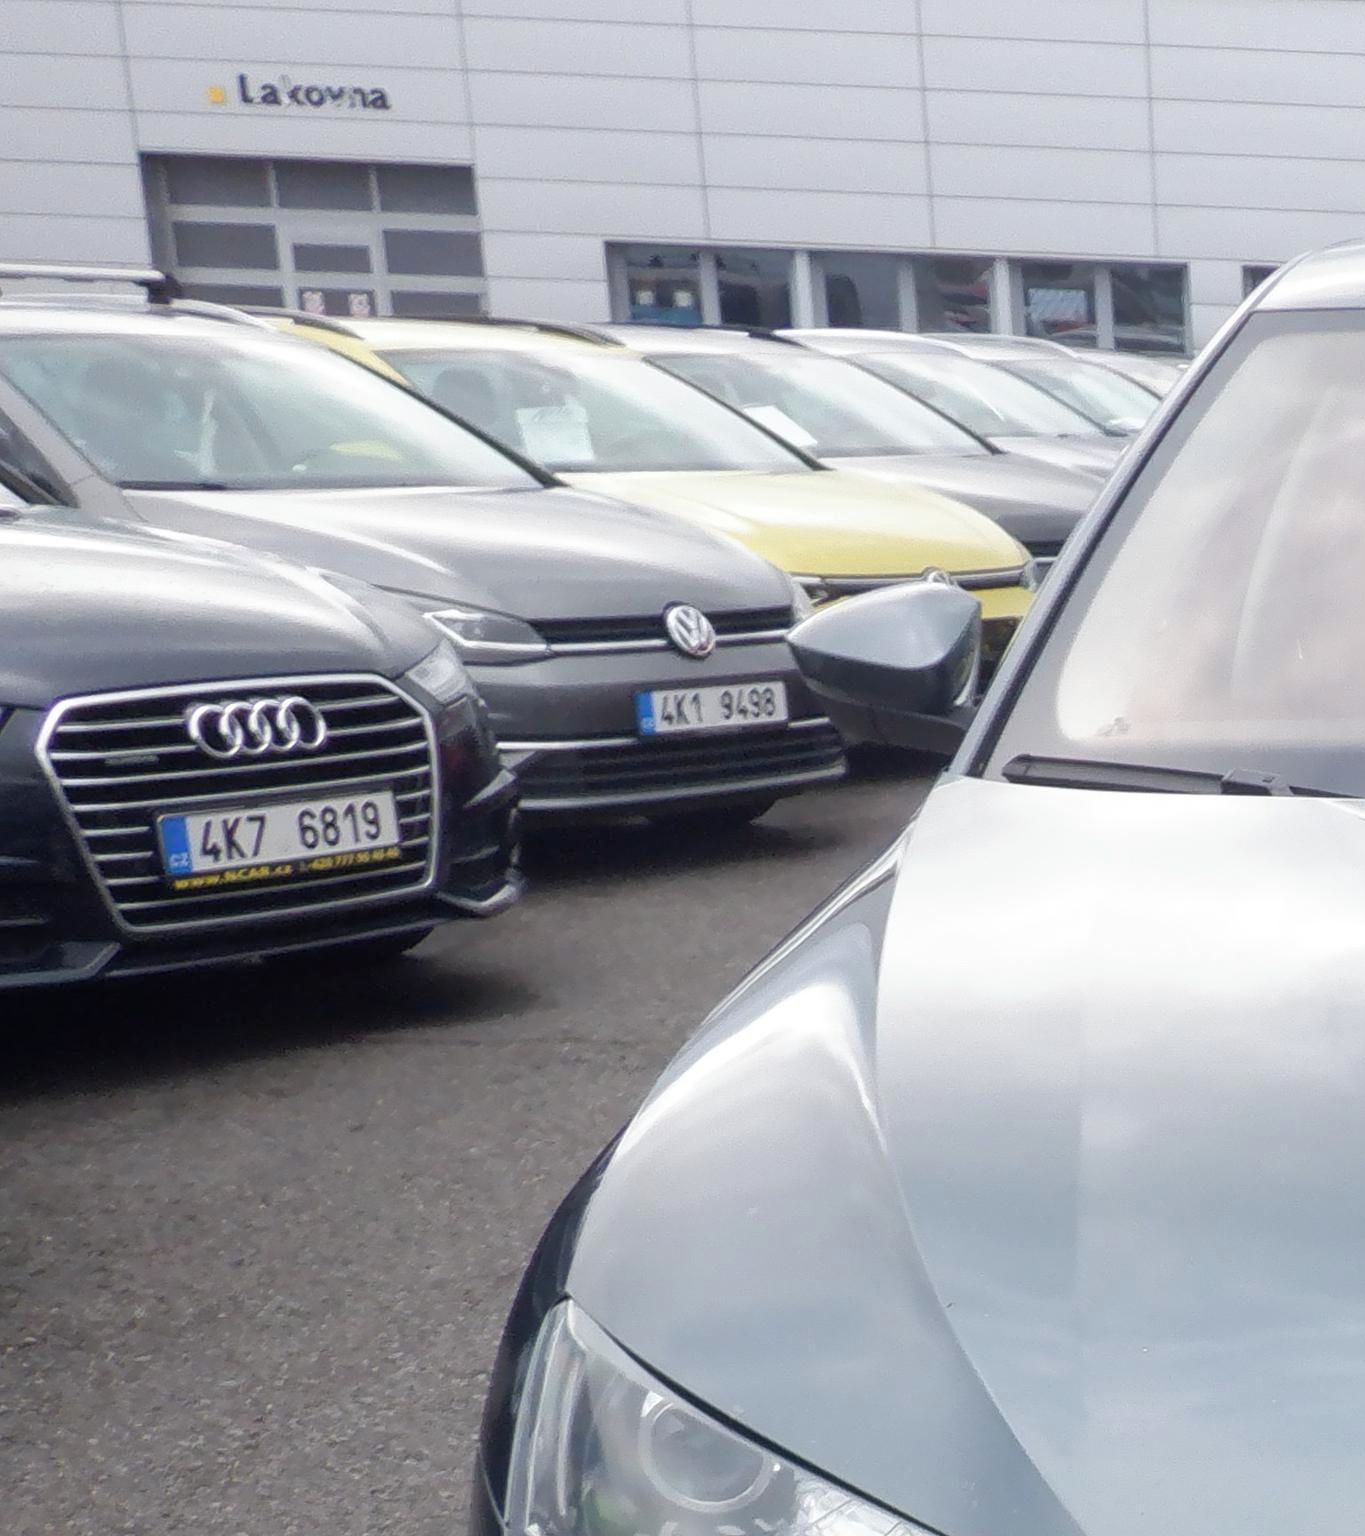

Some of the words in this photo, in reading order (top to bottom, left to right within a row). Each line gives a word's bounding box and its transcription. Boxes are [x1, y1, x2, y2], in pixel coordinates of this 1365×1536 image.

[660, 690, 705, 726] 4K1
[202, 815, 267, 863] 4K7
[298, 801, 382, 850] 6819
